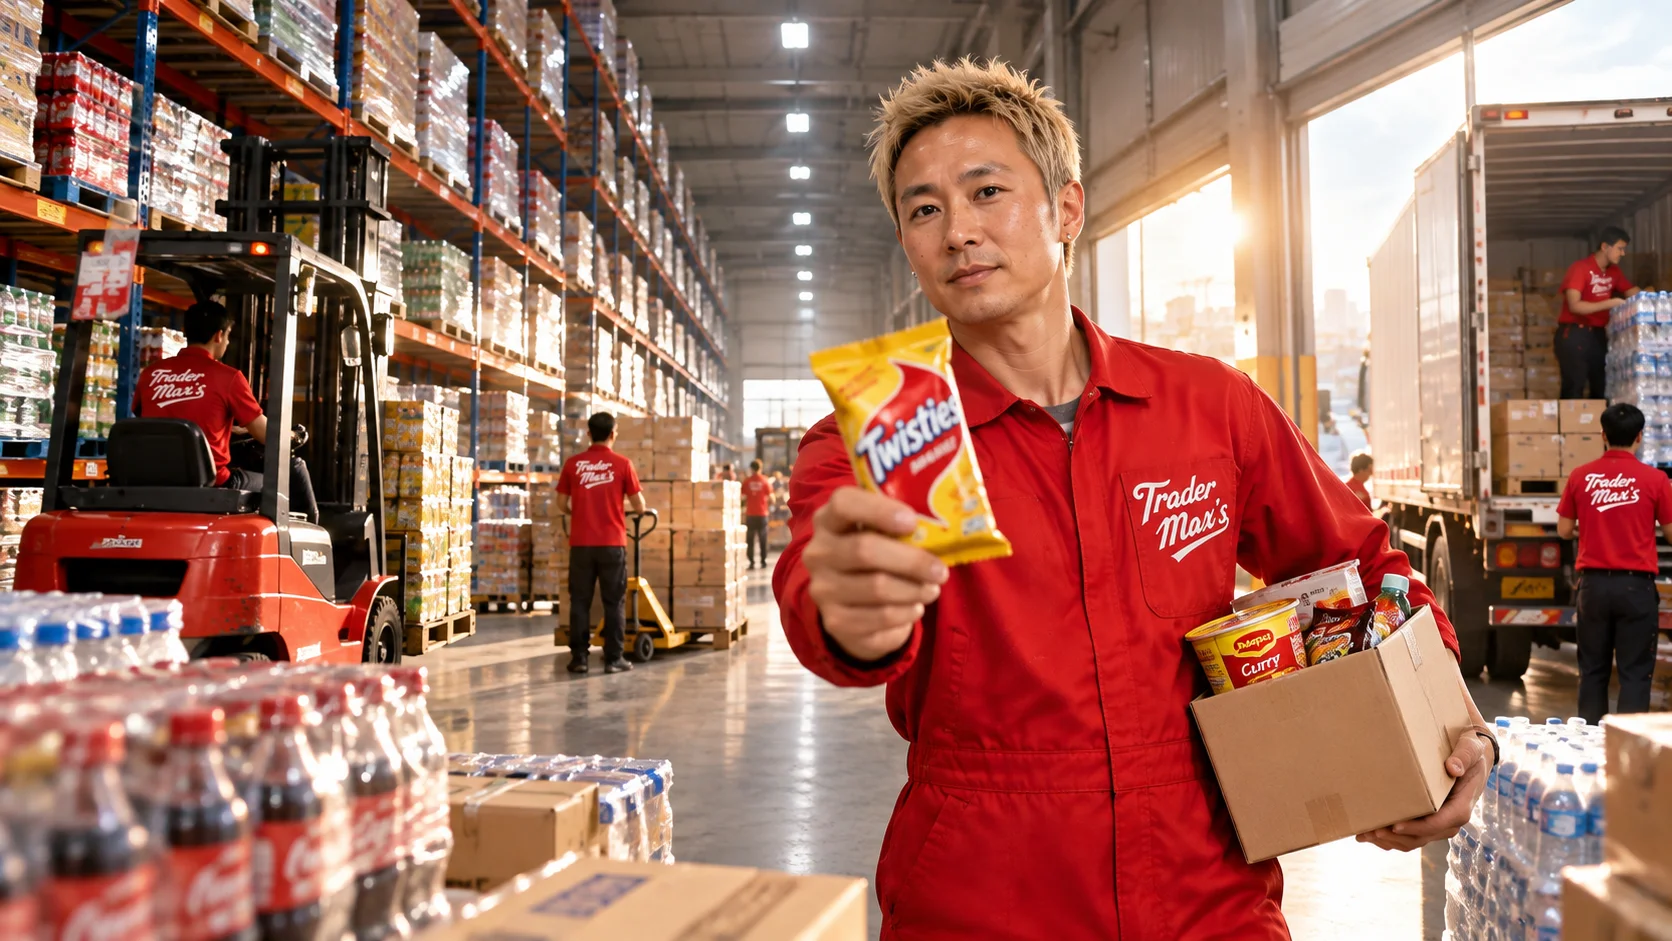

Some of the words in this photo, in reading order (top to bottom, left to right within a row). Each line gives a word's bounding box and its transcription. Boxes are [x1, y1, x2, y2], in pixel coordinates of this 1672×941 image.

[152, 382, 207, 408] Max's
[856, 394, 962, 485] Twisties
[1584, 472, 1636, 492] Trader
[1133, 474, 1217, 526] Trader
[1590, 486, 1640, 512] Max's
[1155, 498, 1230, 562] Max's
[1241, 653, 1280, 677] Curry
